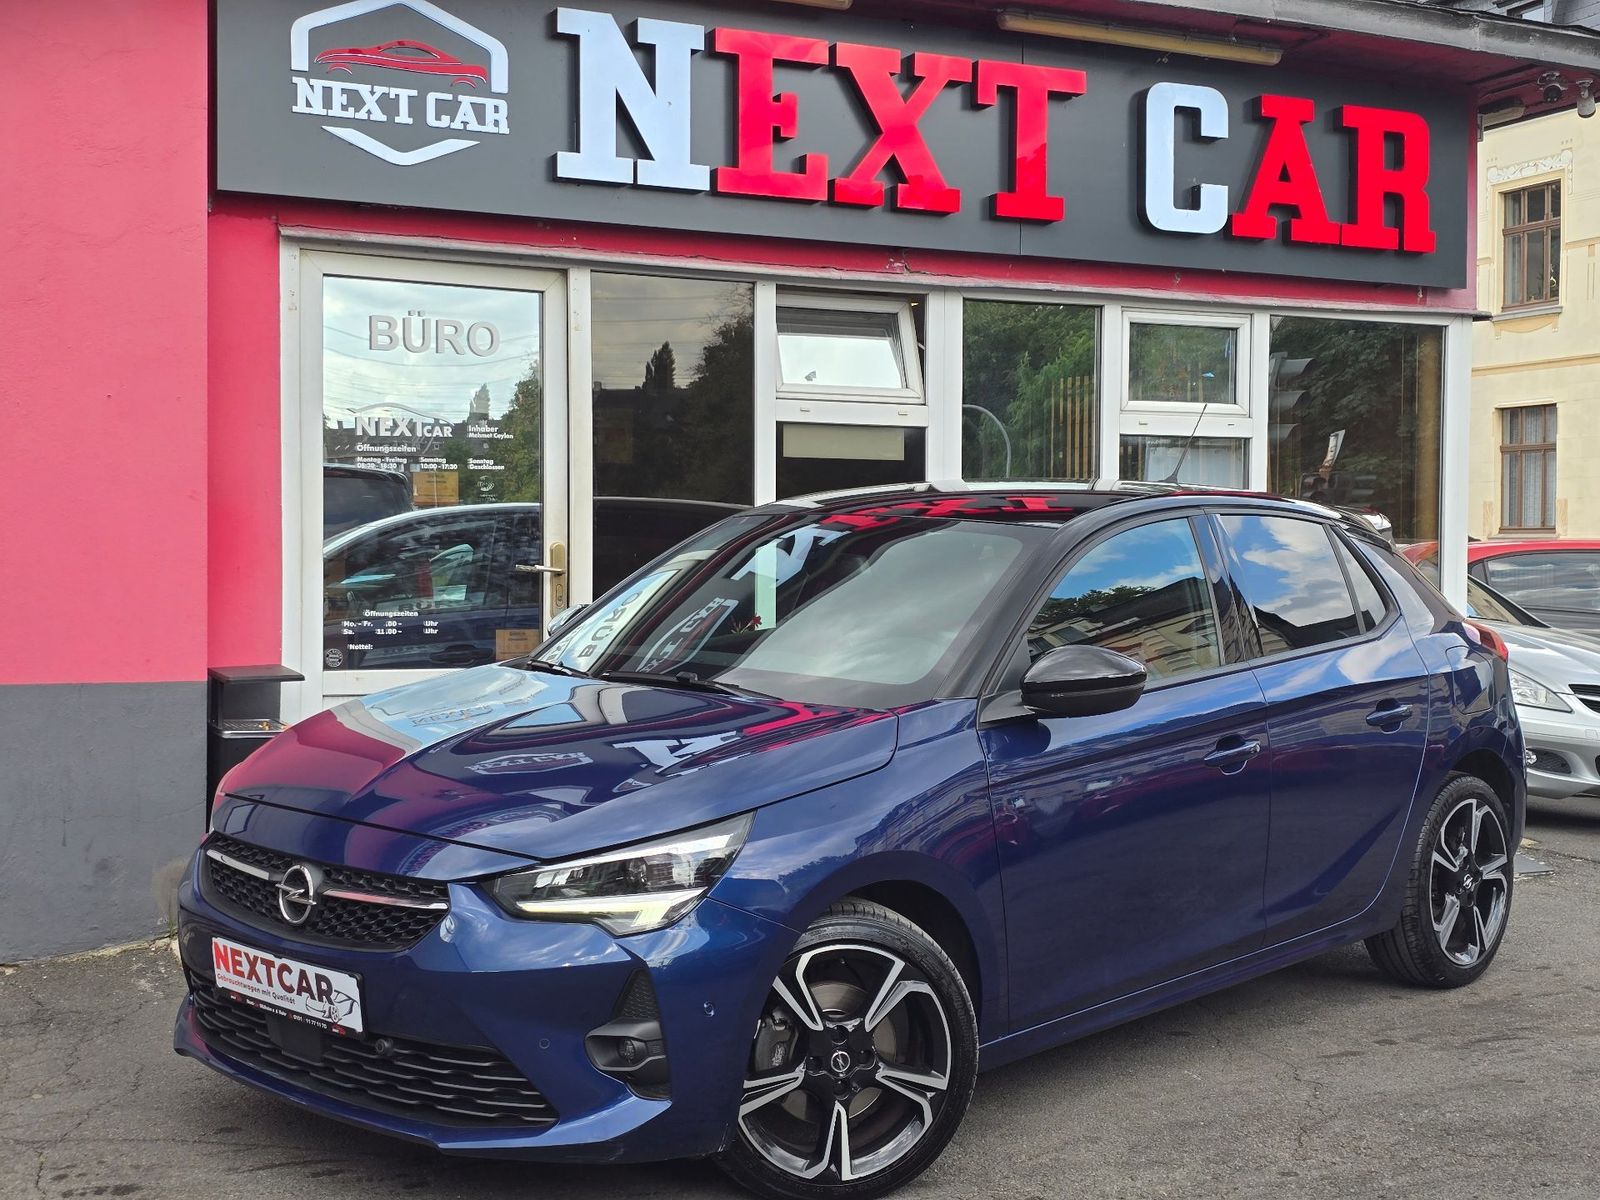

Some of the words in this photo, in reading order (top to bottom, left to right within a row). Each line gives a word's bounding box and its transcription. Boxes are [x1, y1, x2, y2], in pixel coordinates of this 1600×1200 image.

[292, 76, 418, 125] NEXT
[425, 91, 510, 135] CAR
[556, 7, 1087, 222] NEXT
[1144, 81, 1436, 253] CAR
[368, 310, 501, 357] BÜRO
[467, 425, 499, 433] Inhaber
[356, 442, 417, 454] Öffnungszeiten
[385, 456, 407, 464] Freitag
[364, 609, 419, 618] Öffnungszeiten
[213, 941, 336, 1006] NEXTCAR
[217, 973, 261, 995] Gebrauchtwagen
